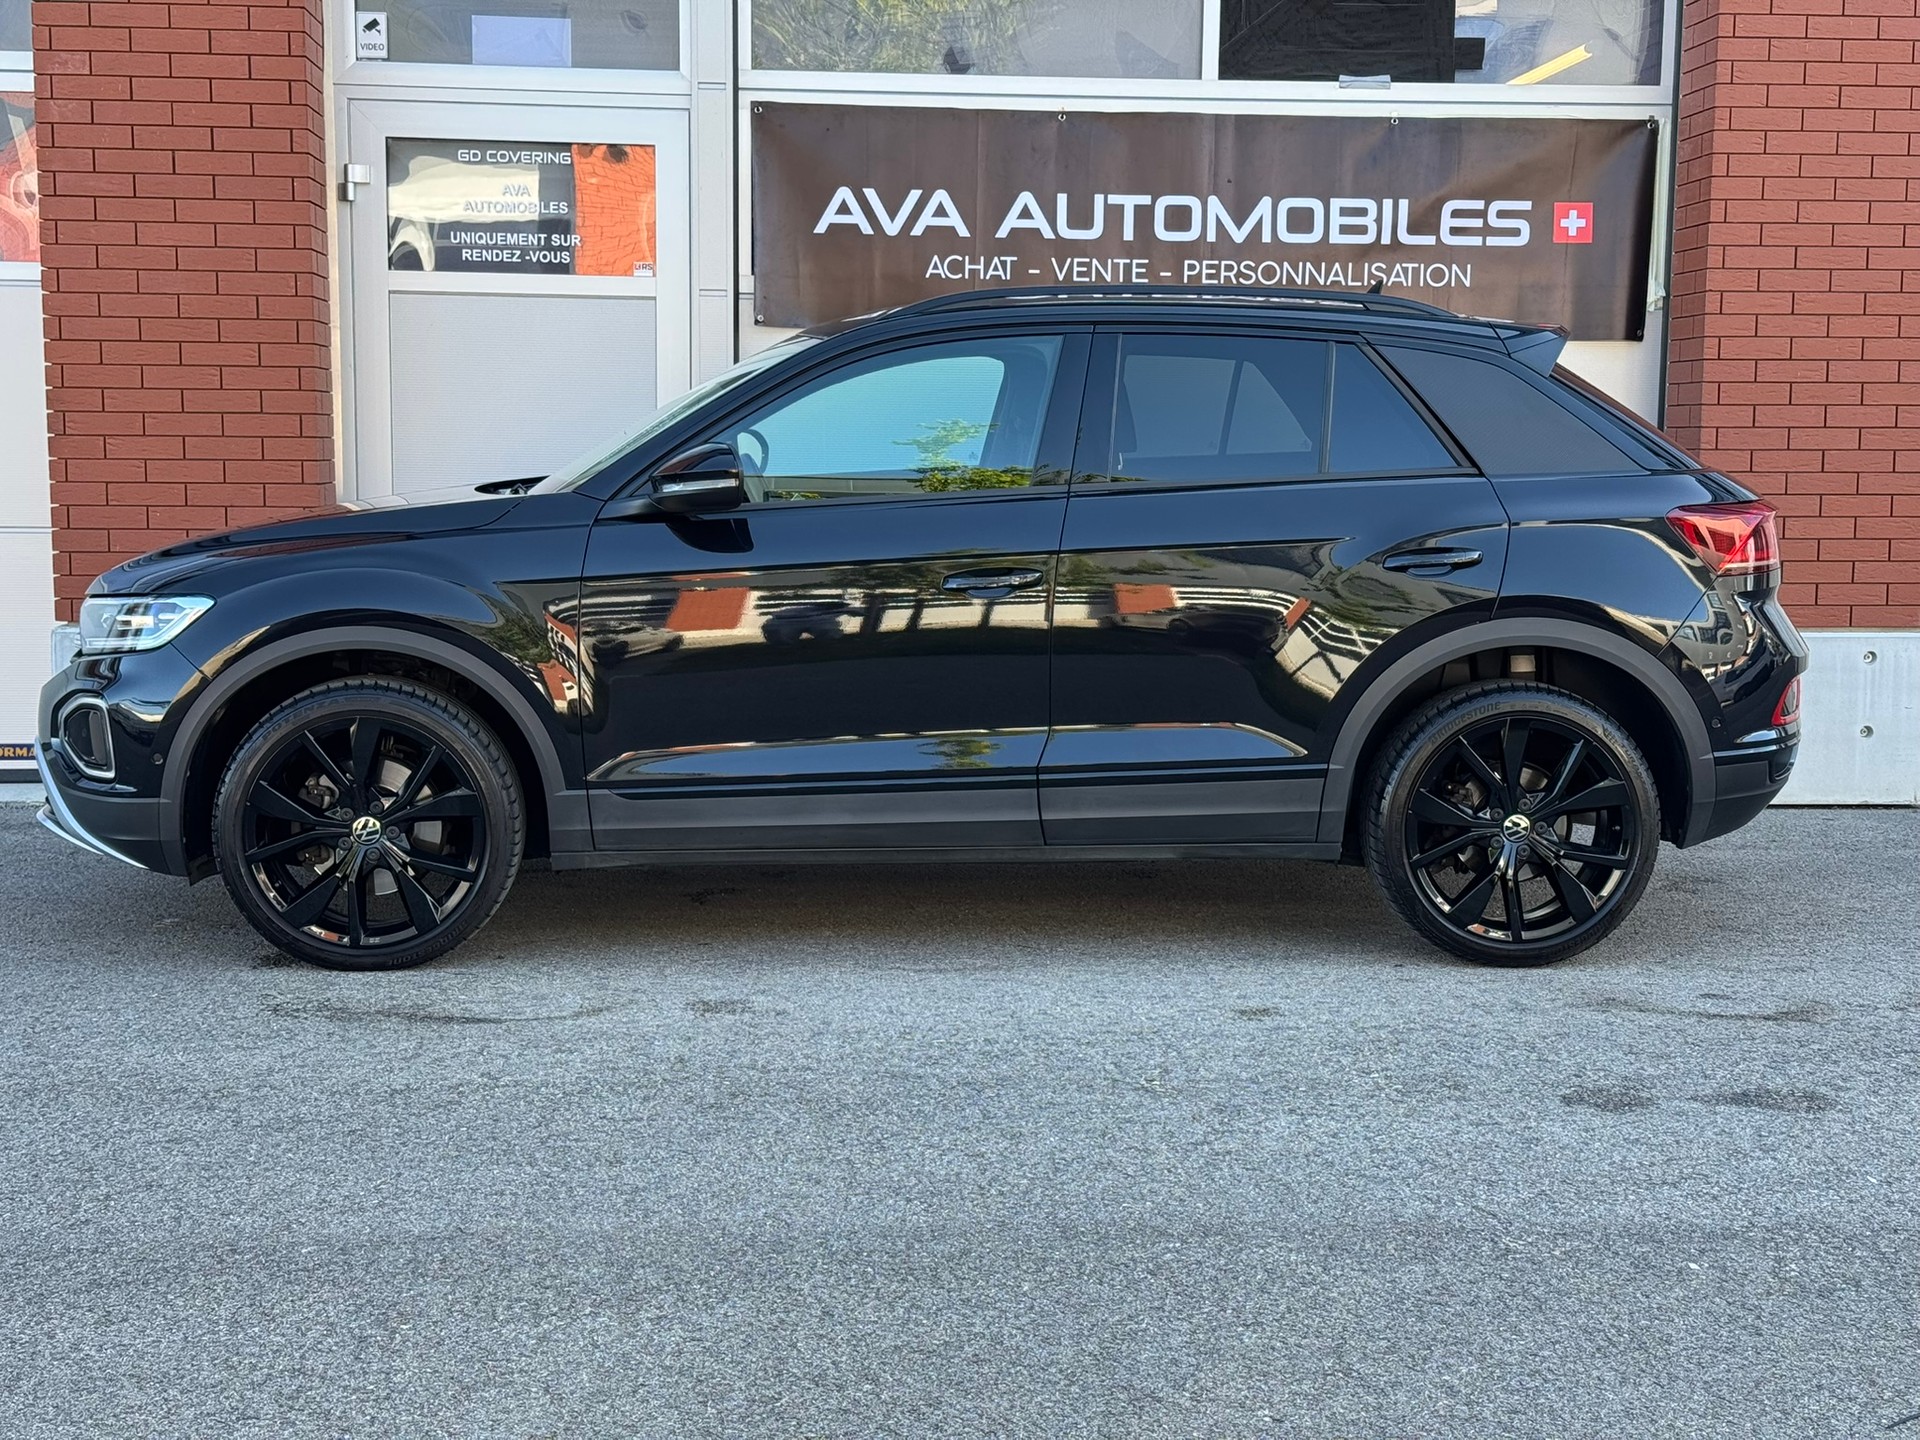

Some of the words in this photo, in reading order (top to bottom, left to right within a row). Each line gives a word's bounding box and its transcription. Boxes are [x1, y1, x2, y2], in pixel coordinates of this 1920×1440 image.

[360, 43, 385, 51] VIDEO
[457, 149, 481, 162] GD
[486, 150, 572, 164] COVERING
[501, 184, 531, 198] AVA
[463, 200, 569, 215] AUTOMOBILES
[812, 185, 971, 238] AVA
[994, 190, 1533, 247] AUTOMOBILES
[450, 231, 547, 247] UNIQUEMENT
[550, 233, 581, 247] SUR
[461, 248, 521, 263] RENDEZ
[925, 254, 1018, 281] ACHAT
[1050, 257, 1150, 284] VENTE
[1183, 259, 1471, 288] PERSONNALISATION
